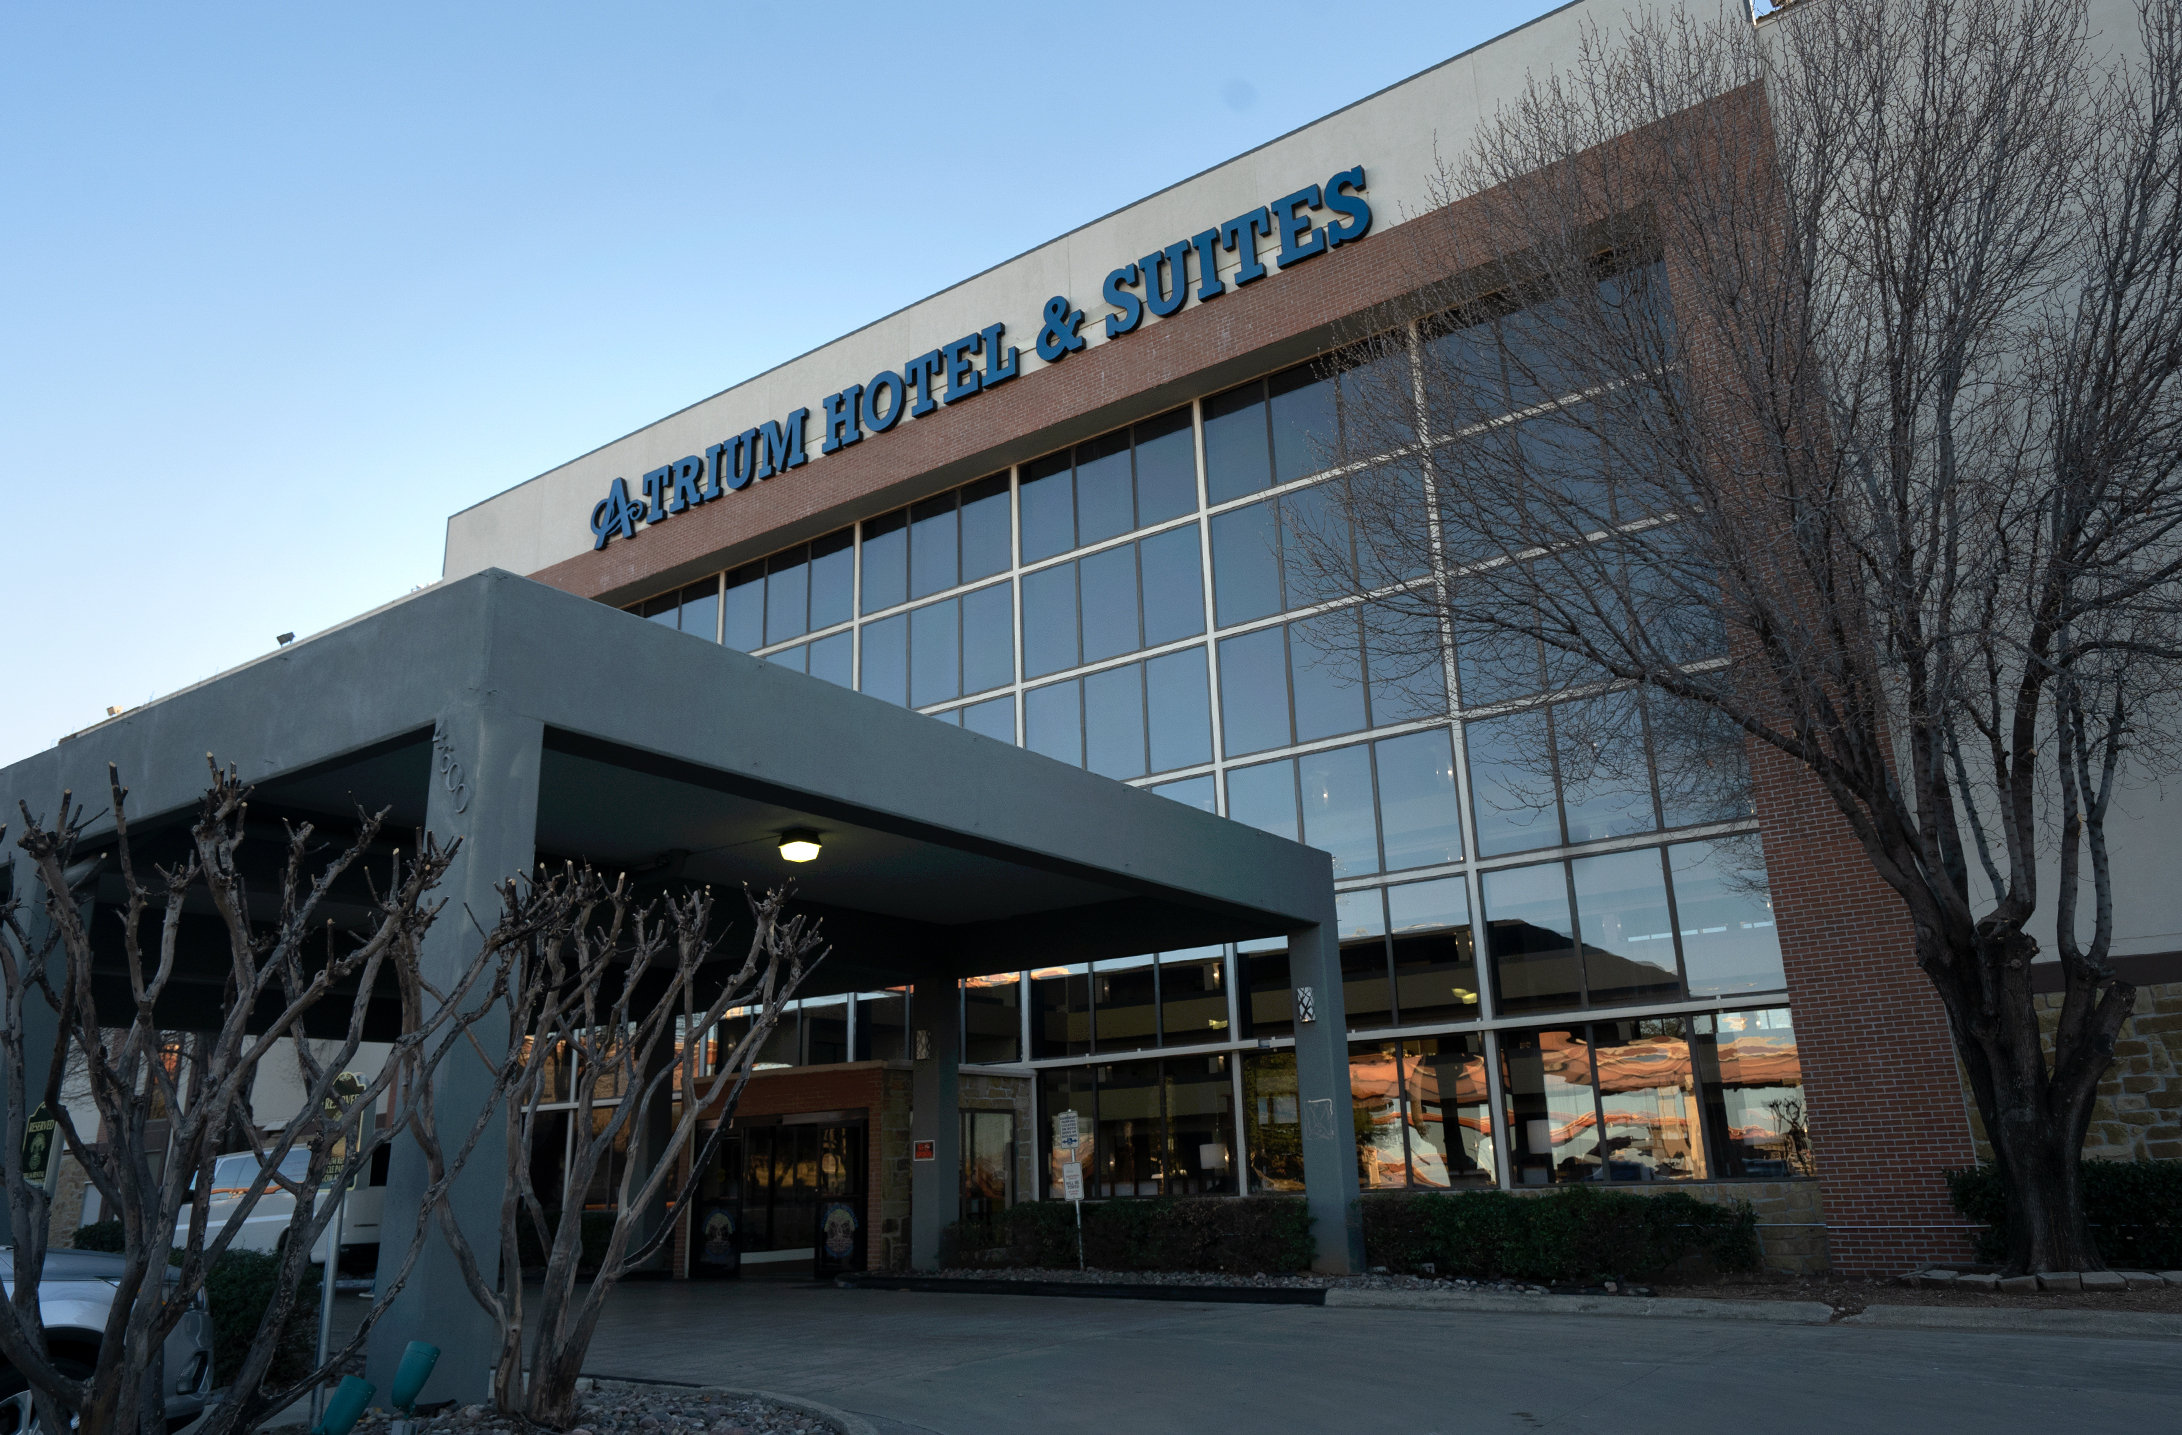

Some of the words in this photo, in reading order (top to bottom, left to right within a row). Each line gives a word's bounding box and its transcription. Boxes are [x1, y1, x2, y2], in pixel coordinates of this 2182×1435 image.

[590, 406, 810, 551] ATRIUM
[821, 321, 1021, 456] HOTEL
[1035, 295, 1087, 364] &
[1102, 164, 1374, 341] SUITES
[29, 1119, 54, 1133] RESERVED
